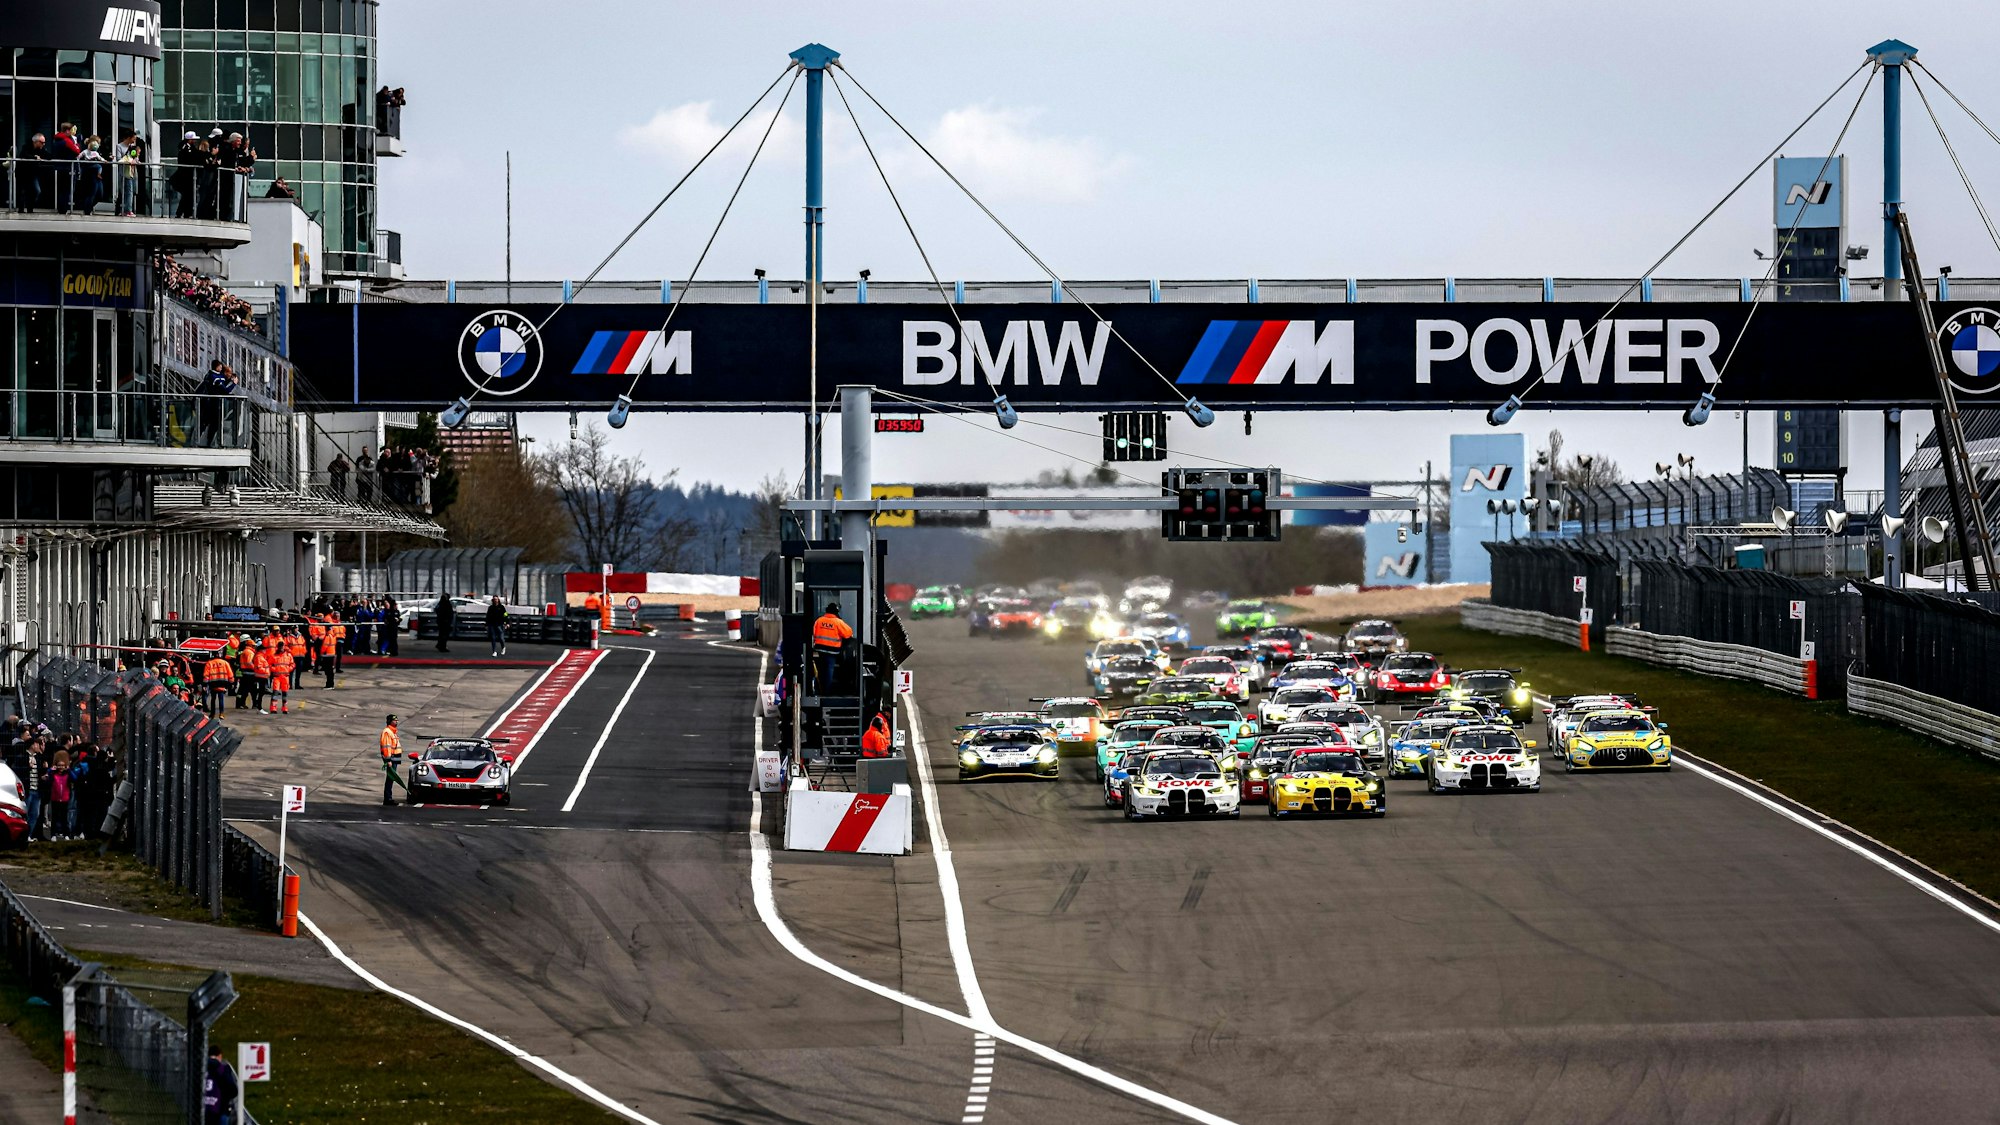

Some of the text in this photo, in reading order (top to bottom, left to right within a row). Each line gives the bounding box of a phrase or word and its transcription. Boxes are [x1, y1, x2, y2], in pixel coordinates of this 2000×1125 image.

[1784, 264, 1790, 274] 1
[1784, 286, 1792, 296] 2
[470, 314, 532, 338] BMW
[903, 320, 1112, 385] BMW
[1415, 317, 1722, 385] POWER
[1784, 410, 1791, 422] 8
[1784, 432, 1792, 442] 9
[1782, 452, 1794, 464] 10
[1805, 644, 1810, 656] 2
[896, 732, 904, 741] 2a
[1158, 780, 1214, 788] ROWE
